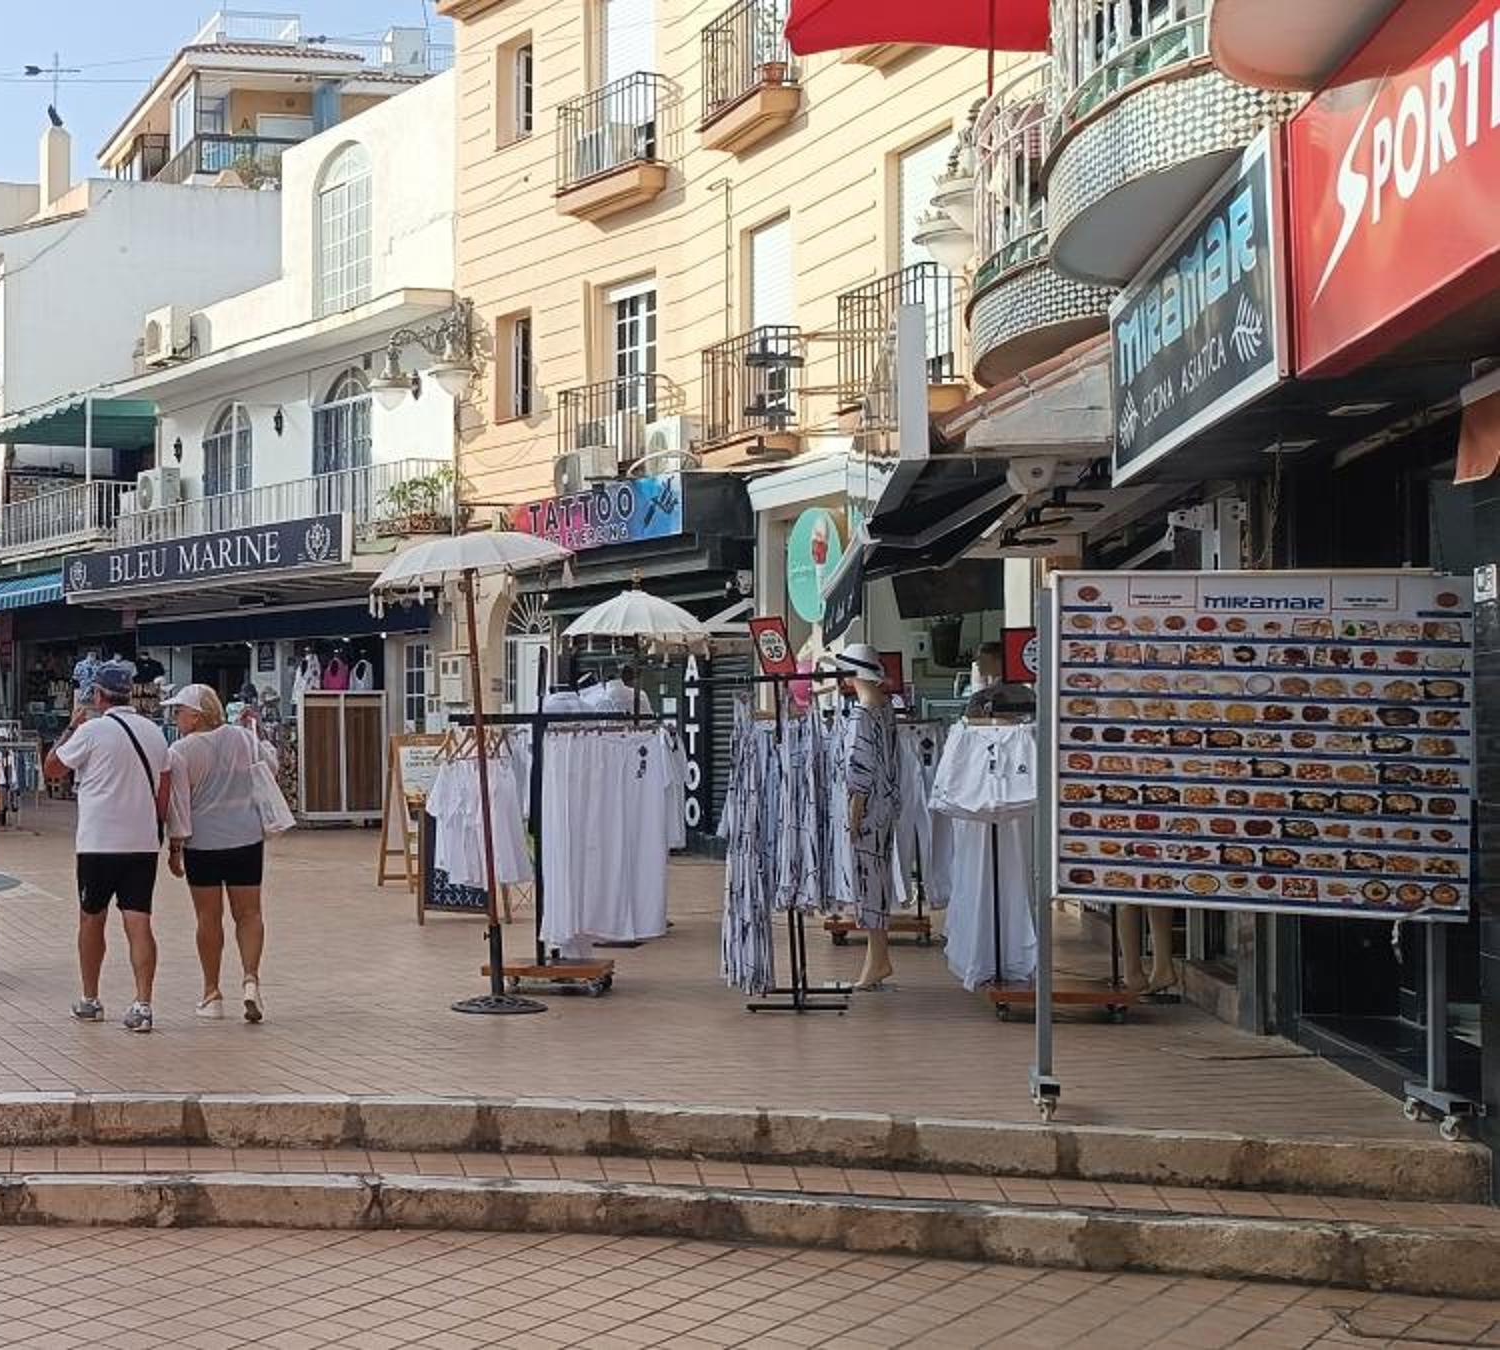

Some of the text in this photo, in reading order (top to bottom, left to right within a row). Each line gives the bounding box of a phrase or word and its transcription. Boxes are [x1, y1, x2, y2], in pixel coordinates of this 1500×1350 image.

[529, 485, 635, 533] TATTOO
[109, 532, 281, 583] BLEU MARINE
[684, 654, 700, 827] ATTOO
